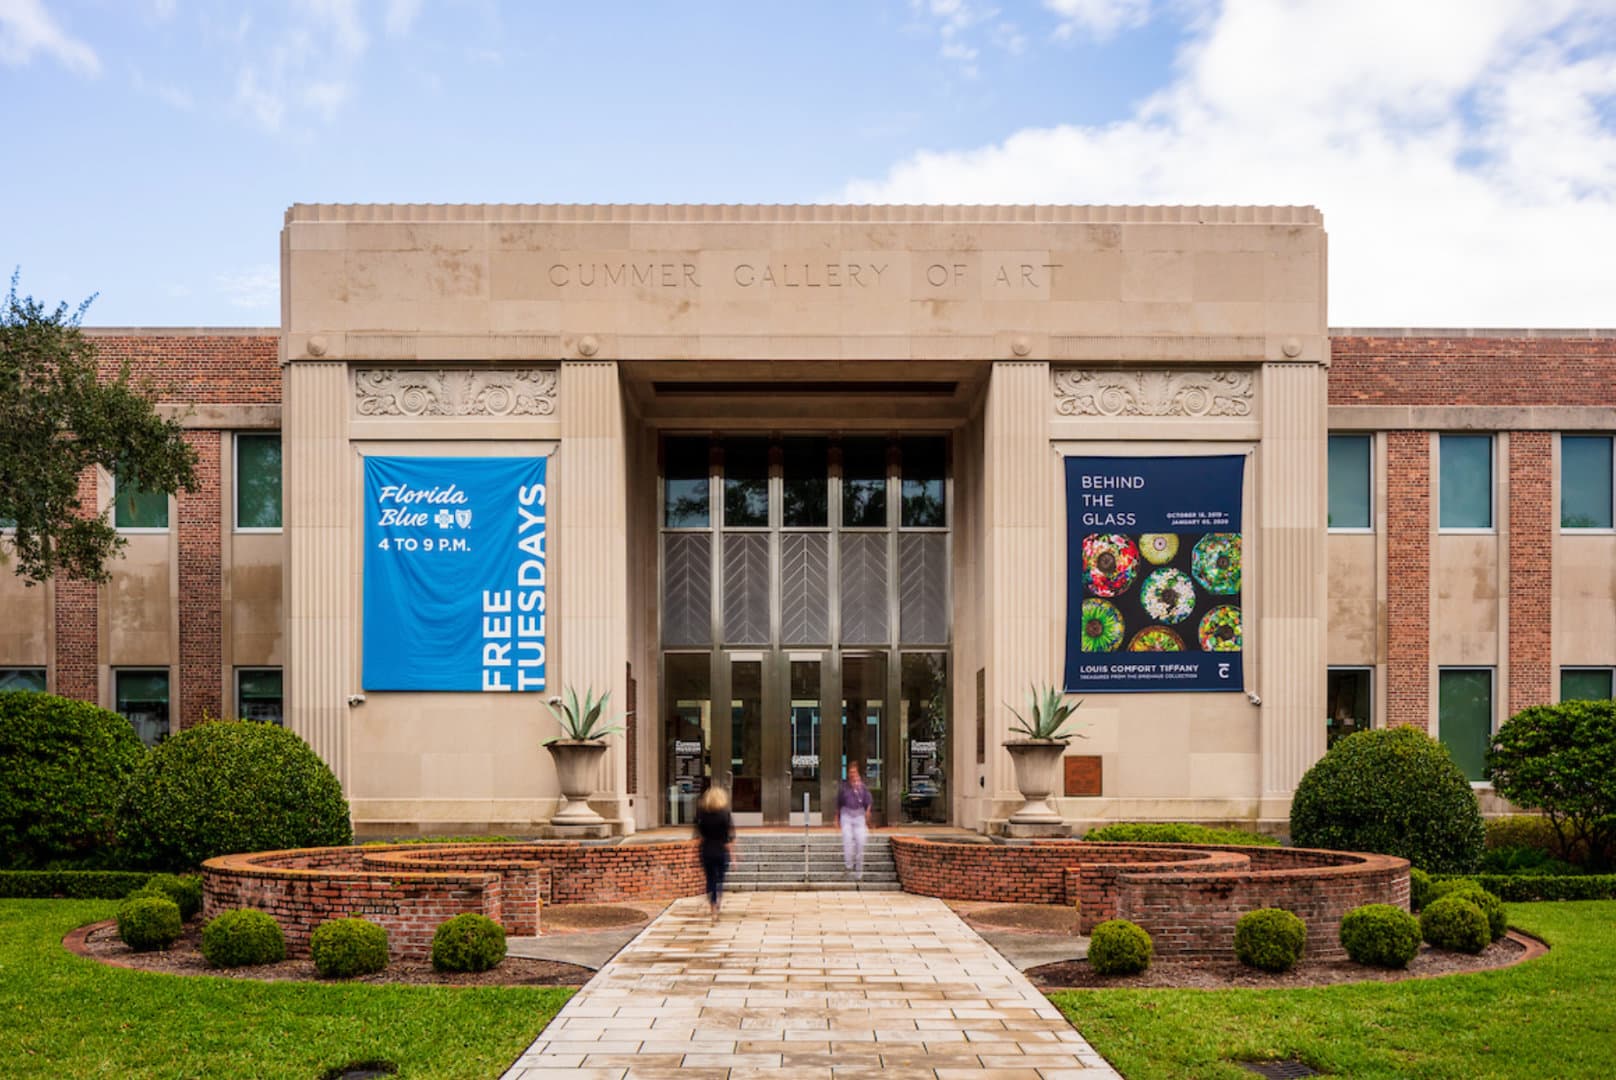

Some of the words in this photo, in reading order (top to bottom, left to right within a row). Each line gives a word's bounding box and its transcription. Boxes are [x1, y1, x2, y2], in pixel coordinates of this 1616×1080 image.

[547, 263, 702, 288] CUMMER
[734, 263, 889, 288] GALLERY
[926, 263, 968, 288] OF
[995, 263, 1064, 288] ART
[1081, 475, 1145, 489] BEHIND
[378, 484, 469, 504] Florida
[1081, 494, 1115, 507] THE
[378, 506, 429, 527] Blue
[1082, 512, 1137, 526] GLASS
[378, 538, 390, 551] 4
[394, 538, 419, 551] TO
[423, 538, 434, 551] 9
[439, 538, 472, 552] P.M.
[518, 483, 546, 692] TUESDAYS
[482, 589, 512, 692] FREE
[1079, 665, 1108, 673] LOUIS
[1110, 664, 1156, 673] COMFORT
[1160, 664, 1199, 672] TIFFANY
